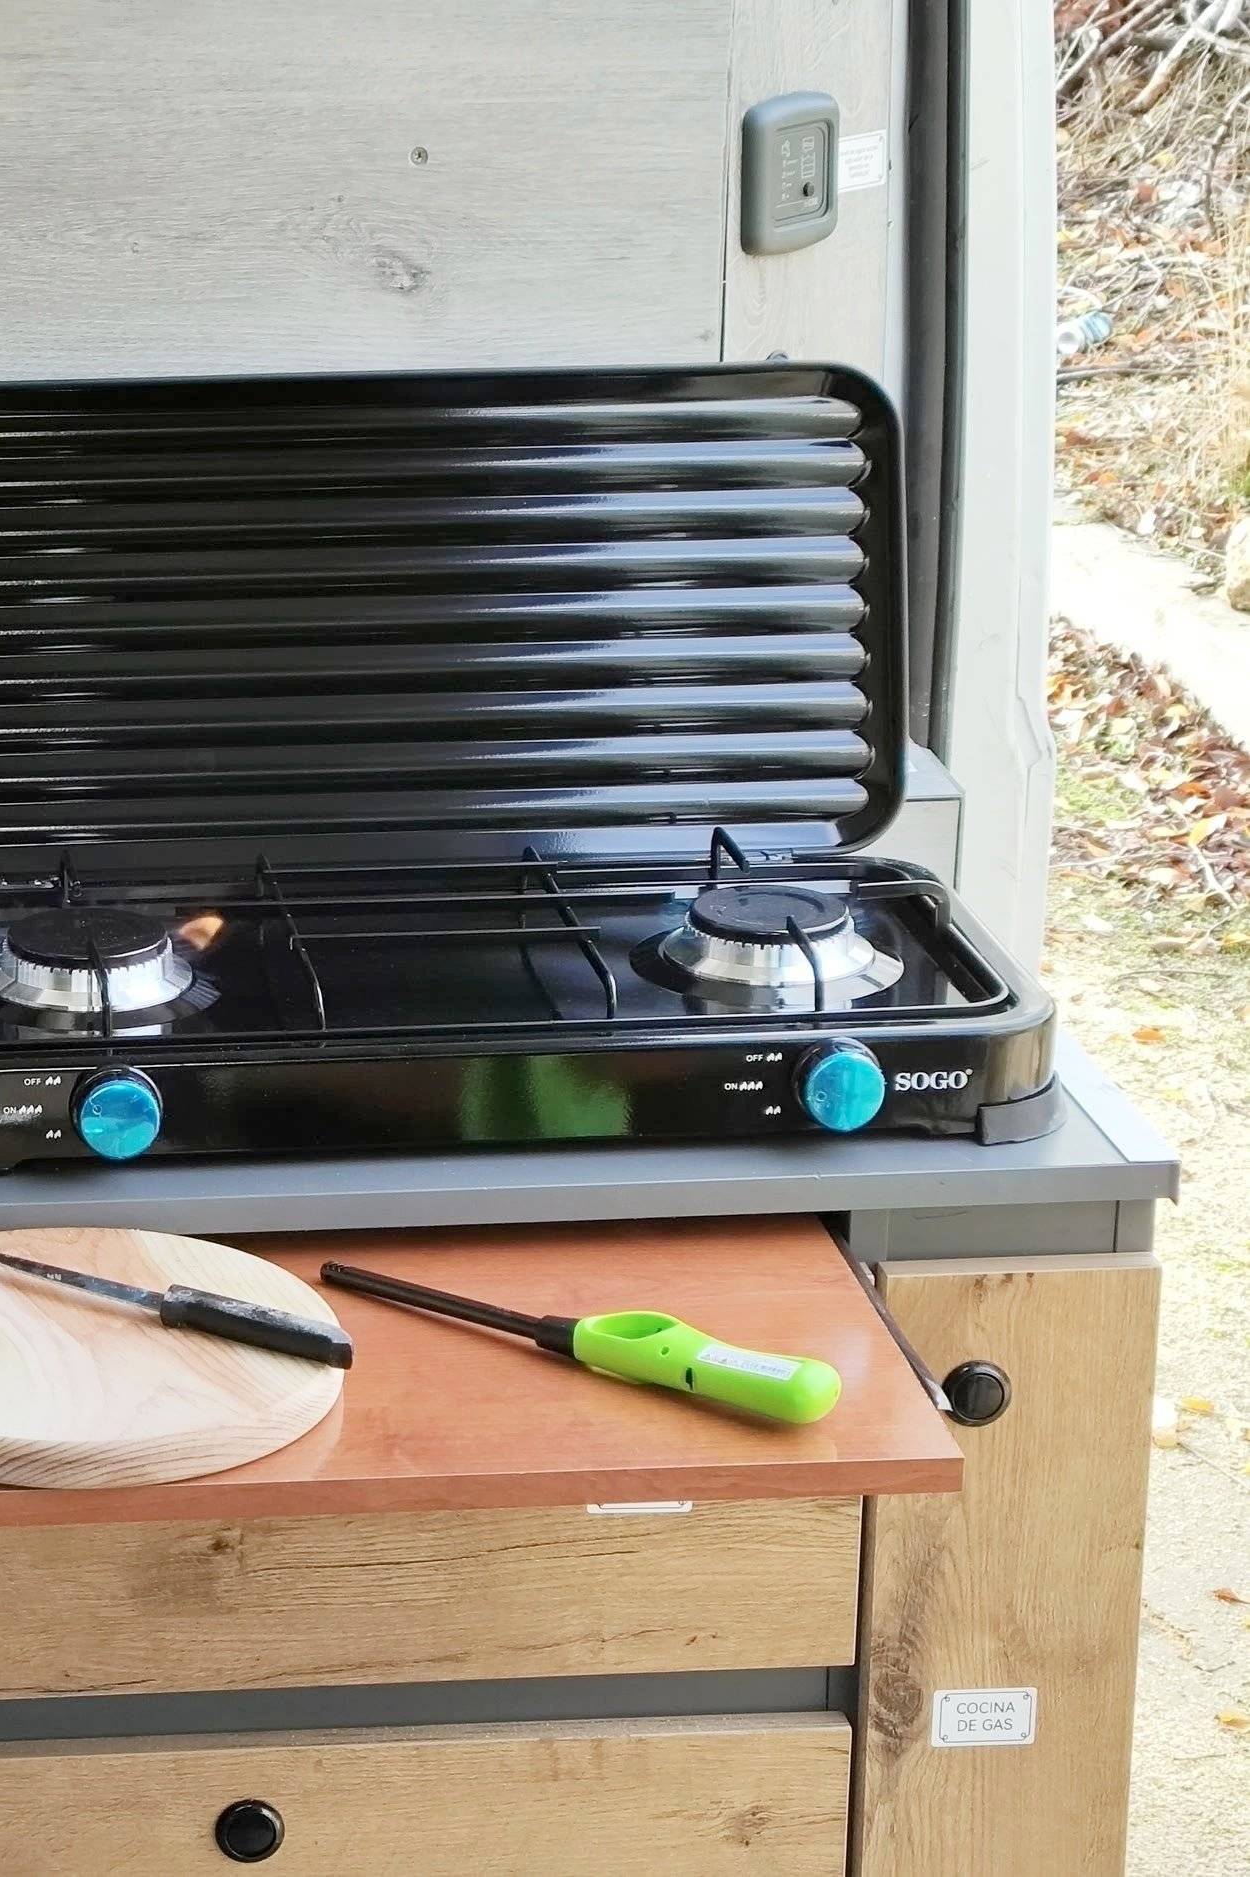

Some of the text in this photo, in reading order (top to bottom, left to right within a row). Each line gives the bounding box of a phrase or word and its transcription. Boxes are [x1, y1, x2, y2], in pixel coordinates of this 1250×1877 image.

[745, 1053, 764, 1063] OFF
[23, 1078, 42, 1086] OFF
[894, 1069, 969, 1092] SOGO
[724, 1082, 738, 1091] ON
[3, 1106, 17, 1114] ON
[956, 1701, 1016, 1715] COCINA
[957, 1718, 1013, 1732] DE GAS
